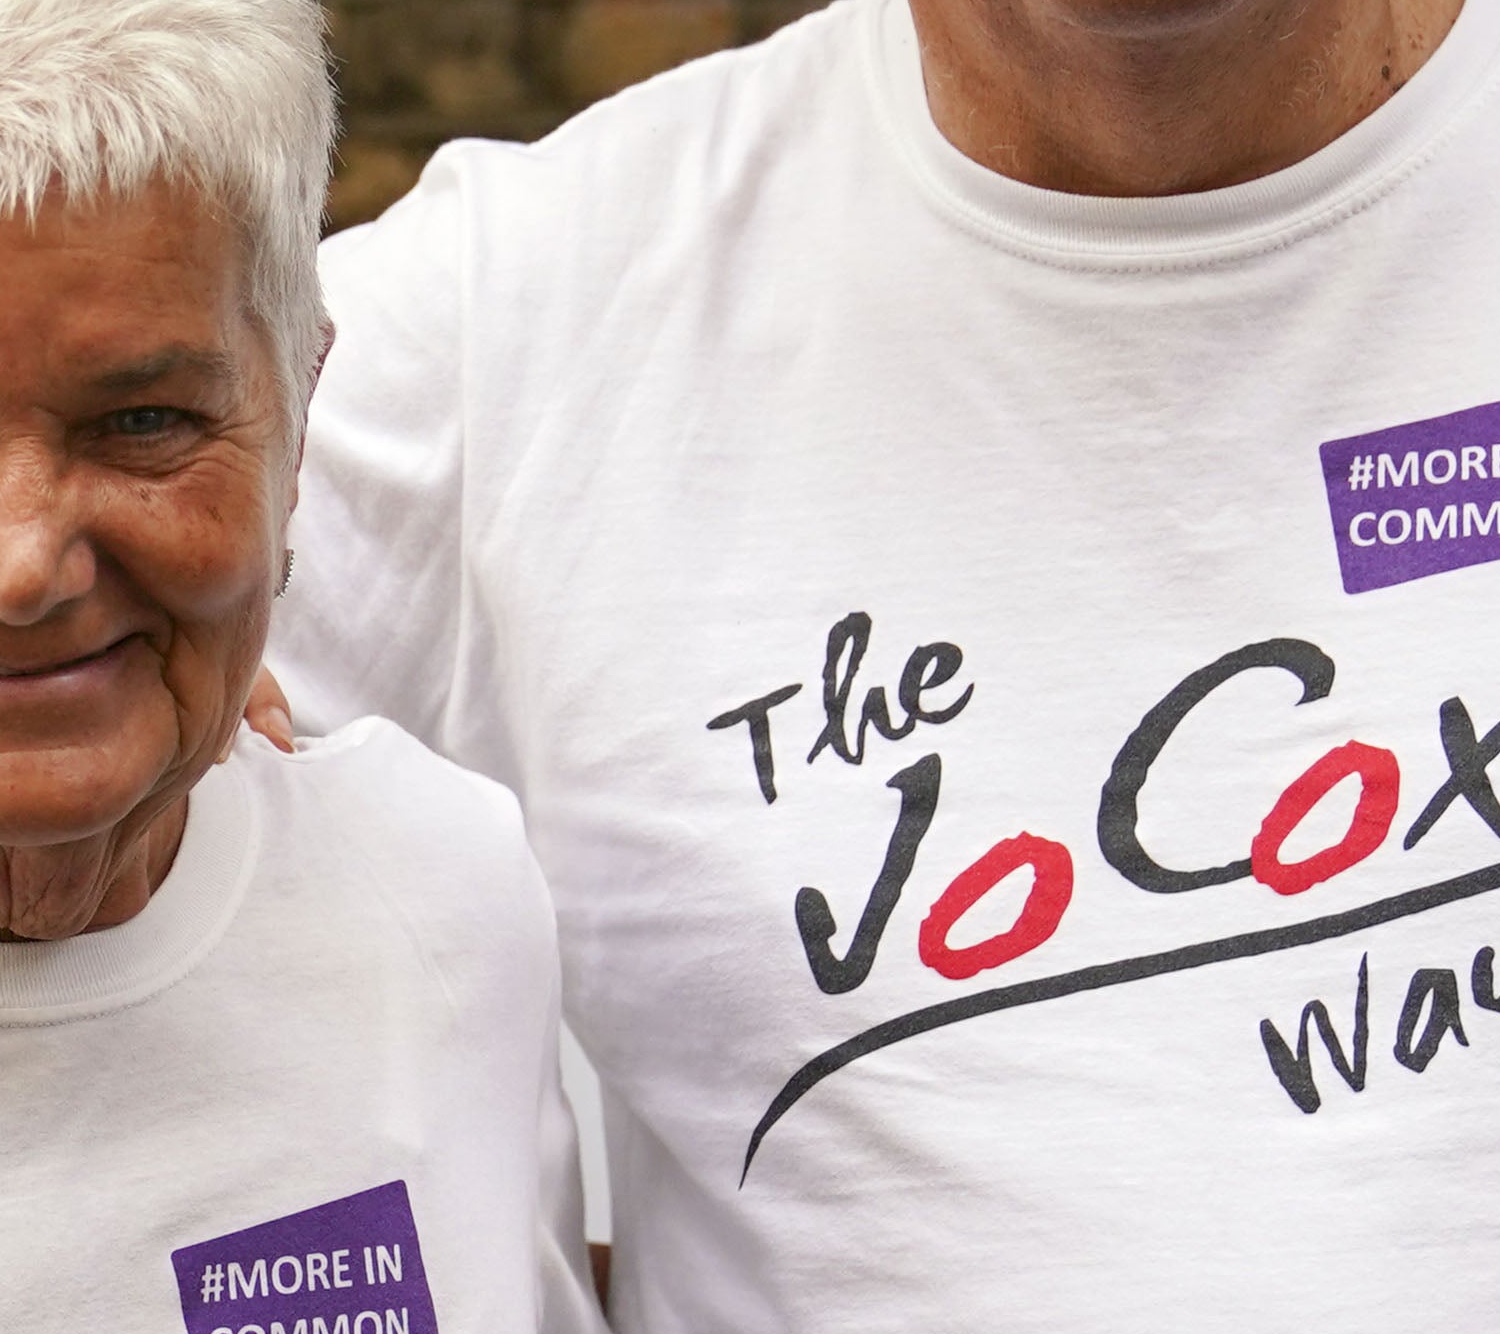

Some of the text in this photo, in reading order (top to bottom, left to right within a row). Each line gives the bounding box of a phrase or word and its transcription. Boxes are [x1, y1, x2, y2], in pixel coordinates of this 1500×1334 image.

[706, 611, 975, 804] The
[794, 753, 1074, 995] Jo
[200, 1243, 404, 1304] #MORE IN
